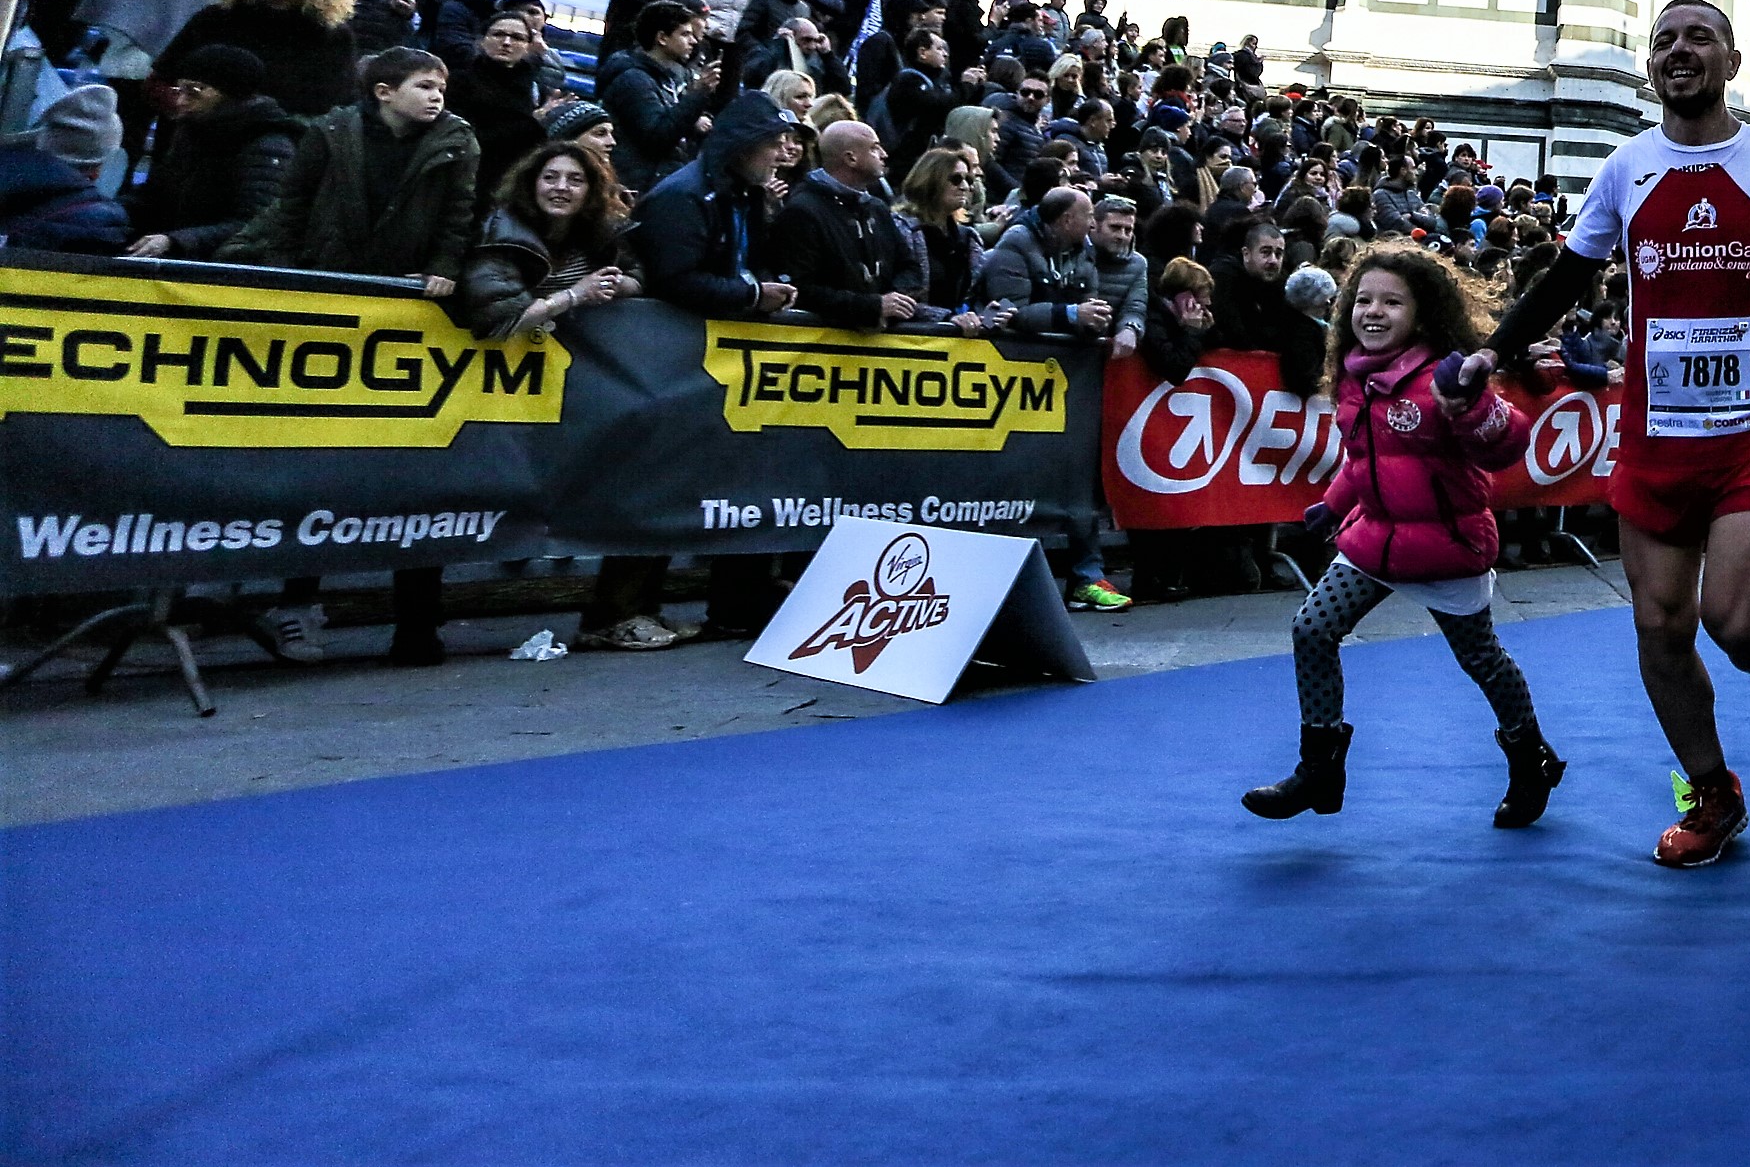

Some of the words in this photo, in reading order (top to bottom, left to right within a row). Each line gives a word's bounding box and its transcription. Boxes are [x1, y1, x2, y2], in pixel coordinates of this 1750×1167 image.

[1663, 330, 1686, 341] asics
[1690, 334, 1744, 344] MARATHON
[1692, 327, 1736, 336] FIRENZE
[1679, 354, 1740, 389] 7878
[701, 499, 761, 530] The
[771, 497, 914, 528] Wellness
[920, 495, 1037, 525] Company
[17, 513, 284, 559] Wellness
[297, 508, 508, 548] Company
[886, 543, 924, 586] Virgin
[797, 596, 950, 652] ACTIVE
